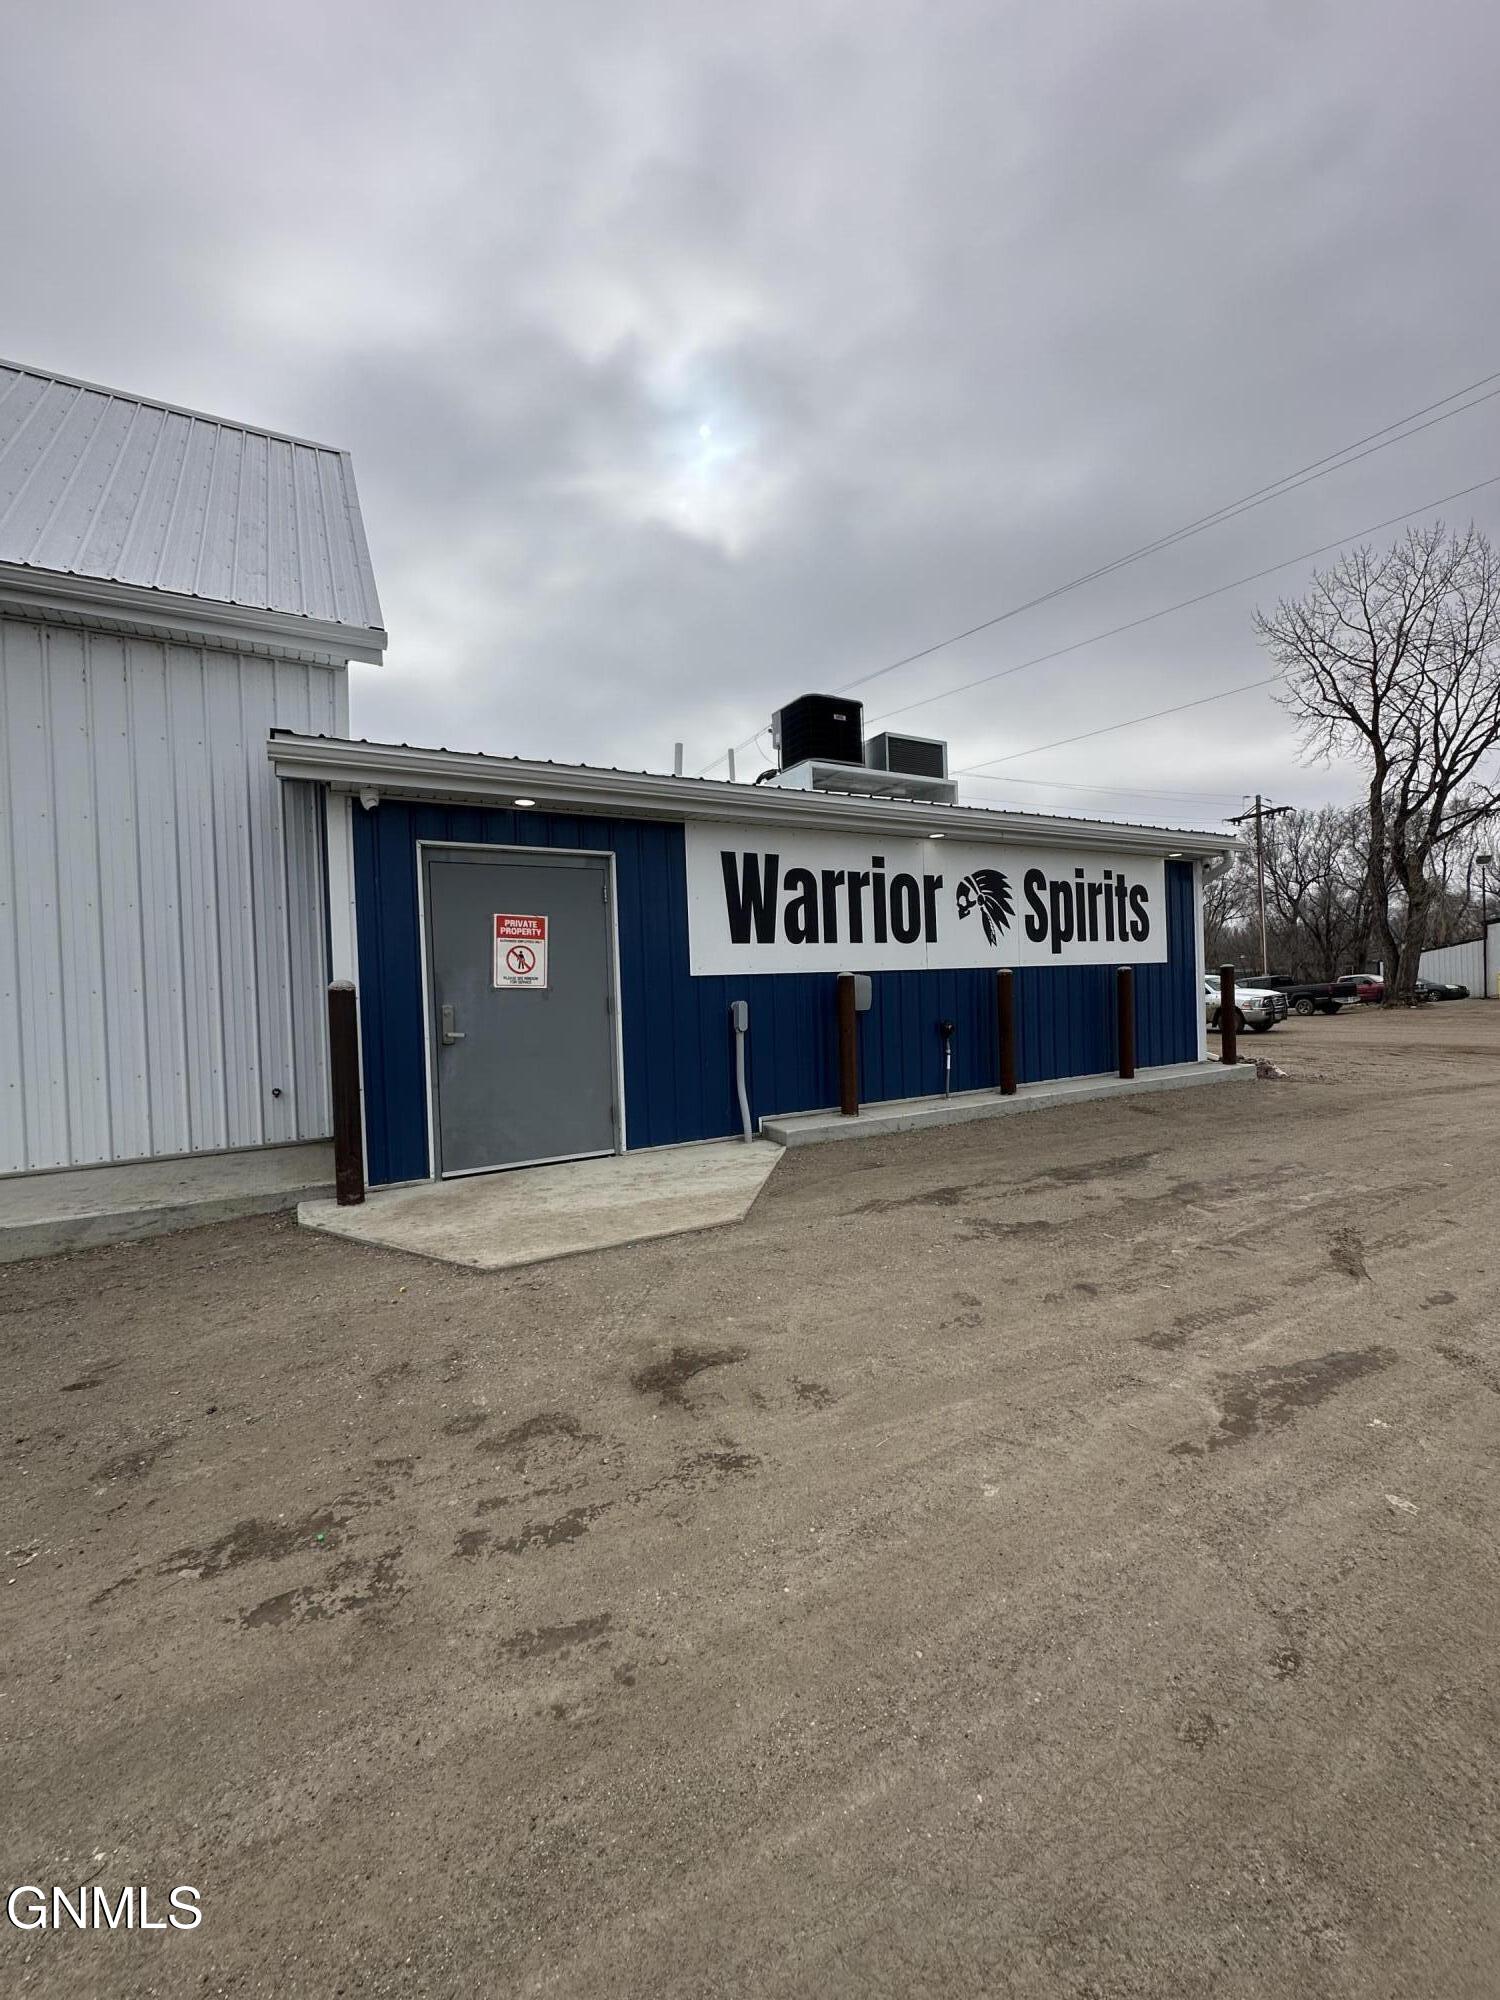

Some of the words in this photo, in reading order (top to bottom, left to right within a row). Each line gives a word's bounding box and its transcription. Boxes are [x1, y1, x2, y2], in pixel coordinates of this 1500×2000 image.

[720, 850, 943, 945] Warrior
[1023, 867, 1150, 954] Spirits
[504, 919, 538, 928] PRIVATE
[500, 926, 541, 936] PROPERTY
